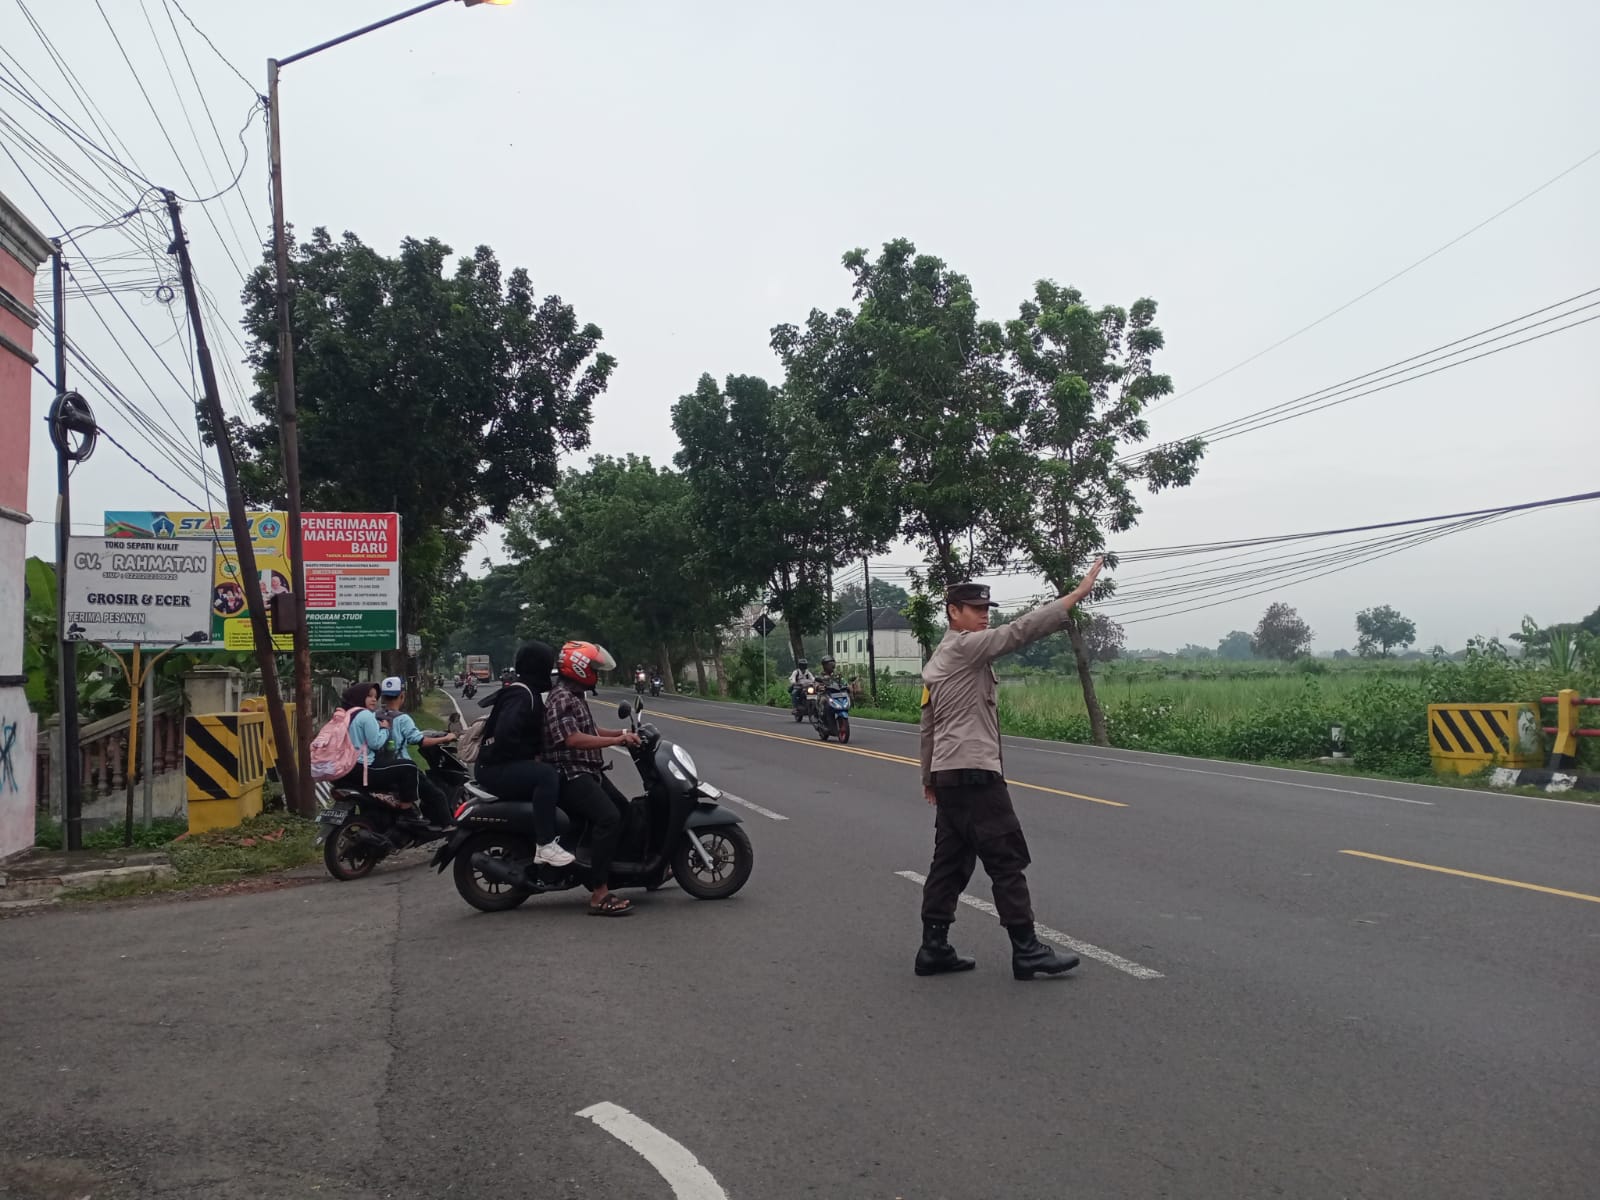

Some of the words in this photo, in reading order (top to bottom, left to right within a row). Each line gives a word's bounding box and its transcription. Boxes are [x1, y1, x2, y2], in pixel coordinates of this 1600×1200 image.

[300, 518, 388, 530] PENERIMAAN
[304, 530, 387, 542] MAHASISWA
[104, 541, 124, 550] TOKO
[126, 541, 155, 550] SEPATU
[156, 543, 179, 551] KULIT
[351, 542, 388, 553] BARU
[75, 552, 102, 570] CV.
[113, 554, 207, 573] RAHMATAN
[87, 593, 138, 606] GROSIR
[141, 594, 152, 606] &
[155, 595, 191, 607] ECER
[68, 611, 101, 623] TERIMA
[102, 612, 146, 624] PESANAN
[305, 613, 341, 621] PROGRAM
[341, 613, 363, 621] STUDI
